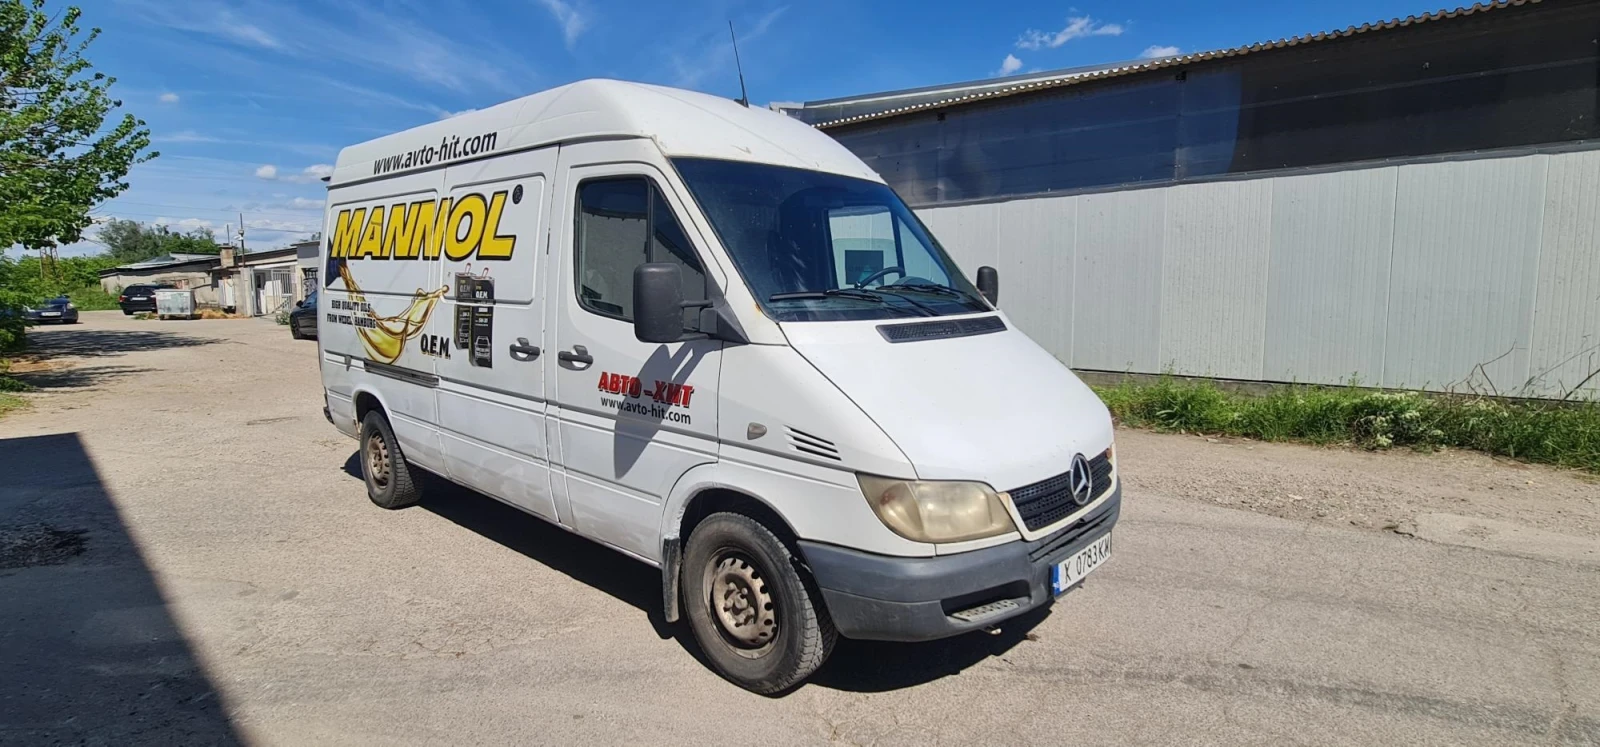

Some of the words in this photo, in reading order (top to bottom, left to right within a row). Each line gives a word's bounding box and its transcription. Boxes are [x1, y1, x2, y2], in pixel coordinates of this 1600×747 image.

[373, 131, 498, 175] www.avto-hit.com
[329, 189, 517, 262] MANNOL
[342, 300, 360, 312] QUALITY
[360, 302, 371, 313] OILS
[326, 312, 338, 323] FROM
[354, 316, 376, 329] HAMBURG
[420, 333, 451, 360] O.E.M.
[600, 397, 692, 425] www.avto-hit.com
